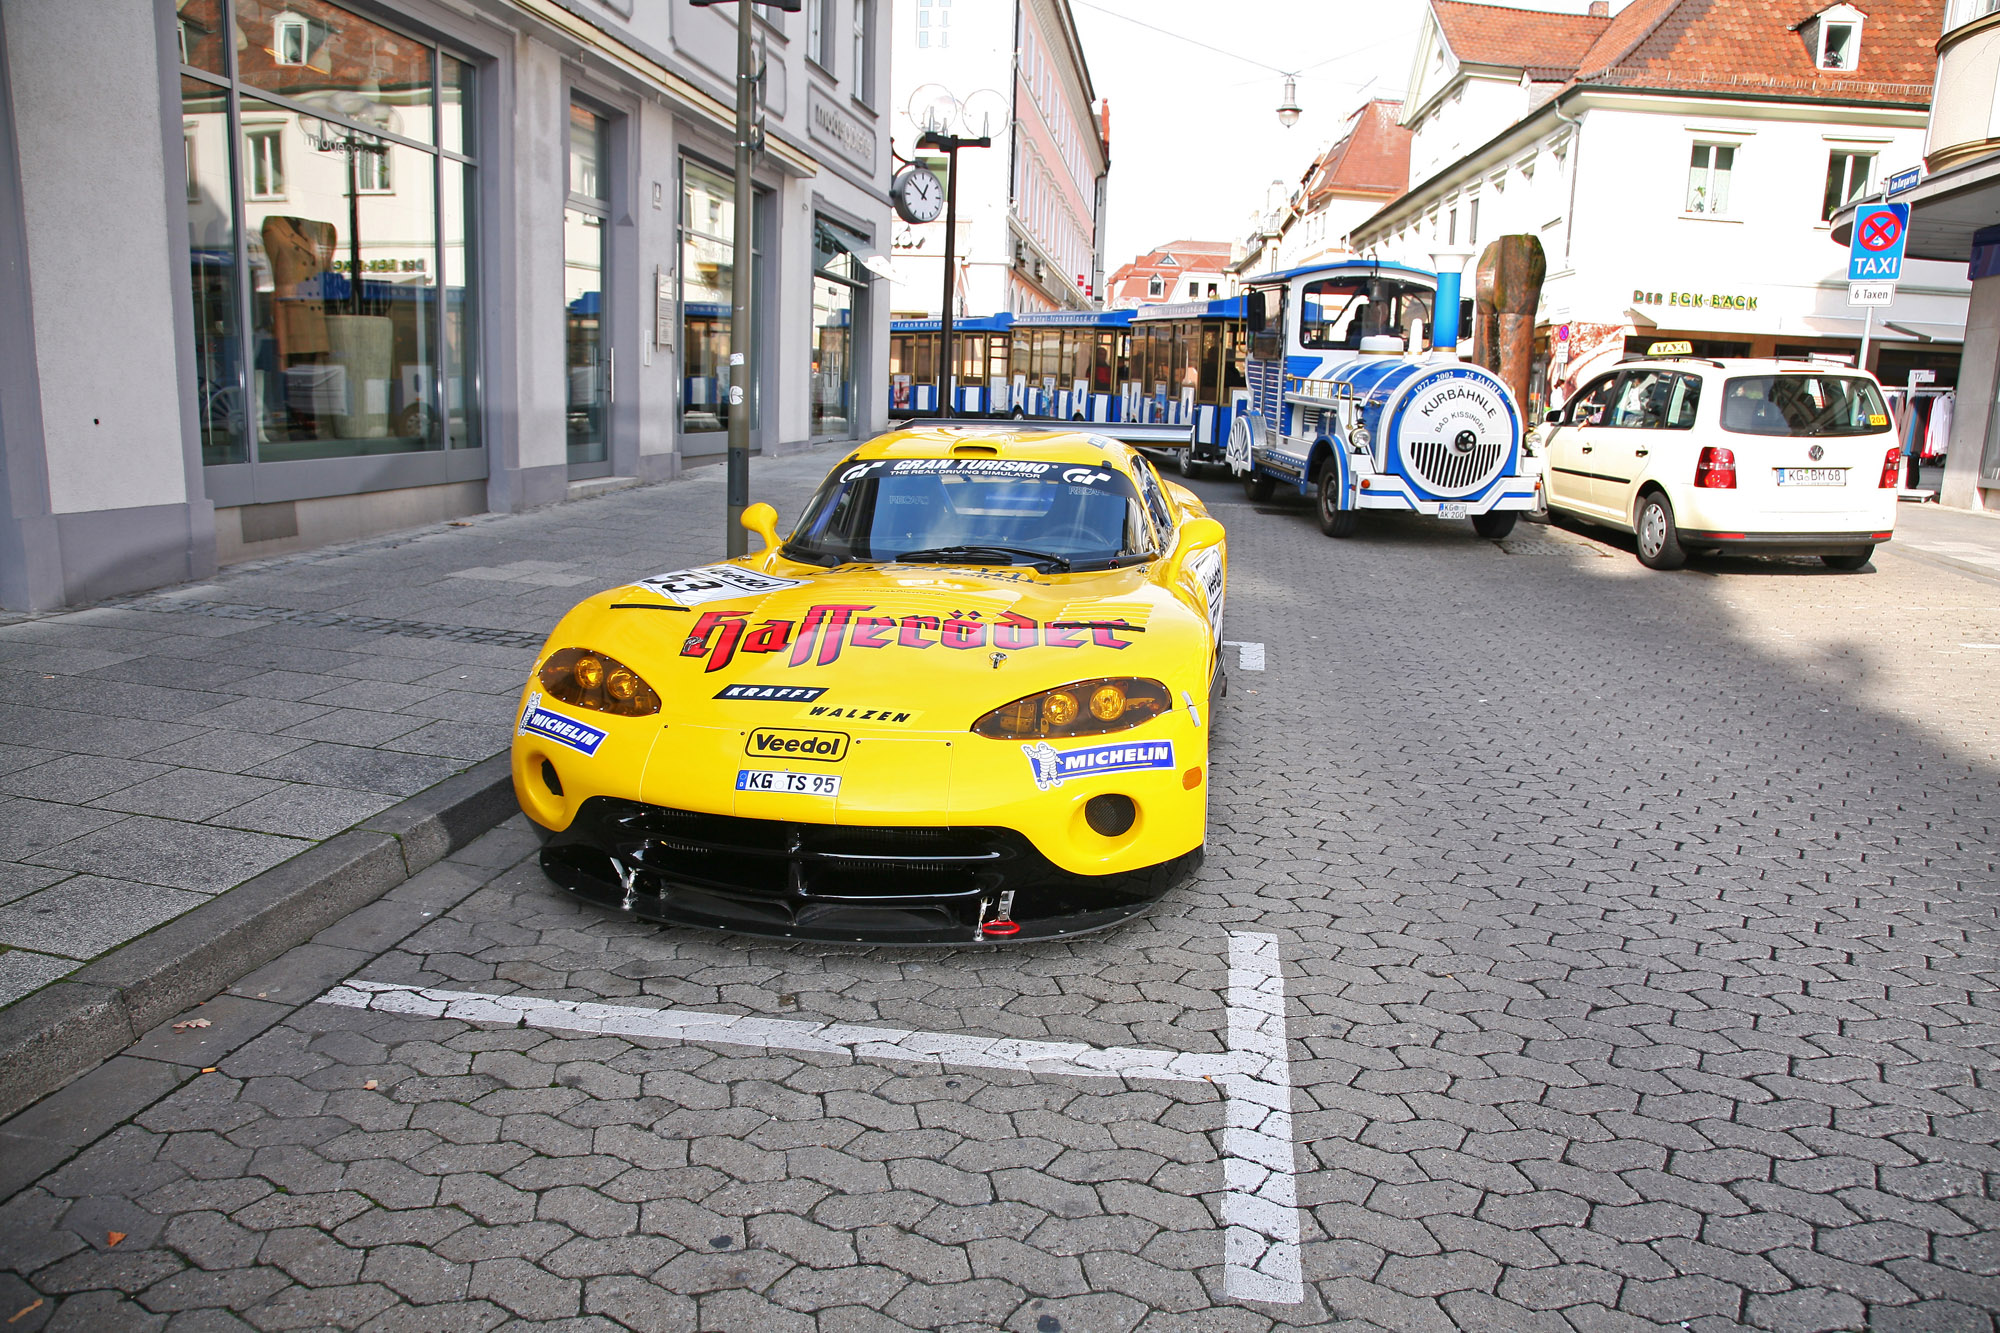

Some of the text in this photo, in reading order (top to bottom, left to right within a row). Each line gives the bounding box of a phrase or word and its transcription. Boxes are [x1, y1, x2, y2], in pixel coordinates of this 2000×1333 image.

[1854, 257, 1898, 275] TAXI
[1854, 289, 1889, 299] 6 Taxen
[1656, 342, 1690, 353] TAXI
[1464, 371, 1475, 380] 25
[1475, 373, 1504, 397] JAHRE
[1421, 385, 1497, 419] KURBÄHNLE
[1435, 411, 1486, 434] BAD KISSINGEN
[1871, 416, 1886, 424] 201
[894, 460, 1050, 474] GRAN TURISMO
[981, 470, 1041, 479] SIMULATOR
[1788, 469, 1841, 481] KG BM 68
[726, 687, 820, 699] KRAFFT
[808, 706, 911, 723] WALZEN
[530, 713, 600, 746] MICHELIN
[756, 734, 841, 755] Veedol
[1065, 747, 1169, 770] MICHELIN
[749, 773, 774, 789] KG
[787, 775, 807, 791] TS
[813, 777, 836, 793] 95
